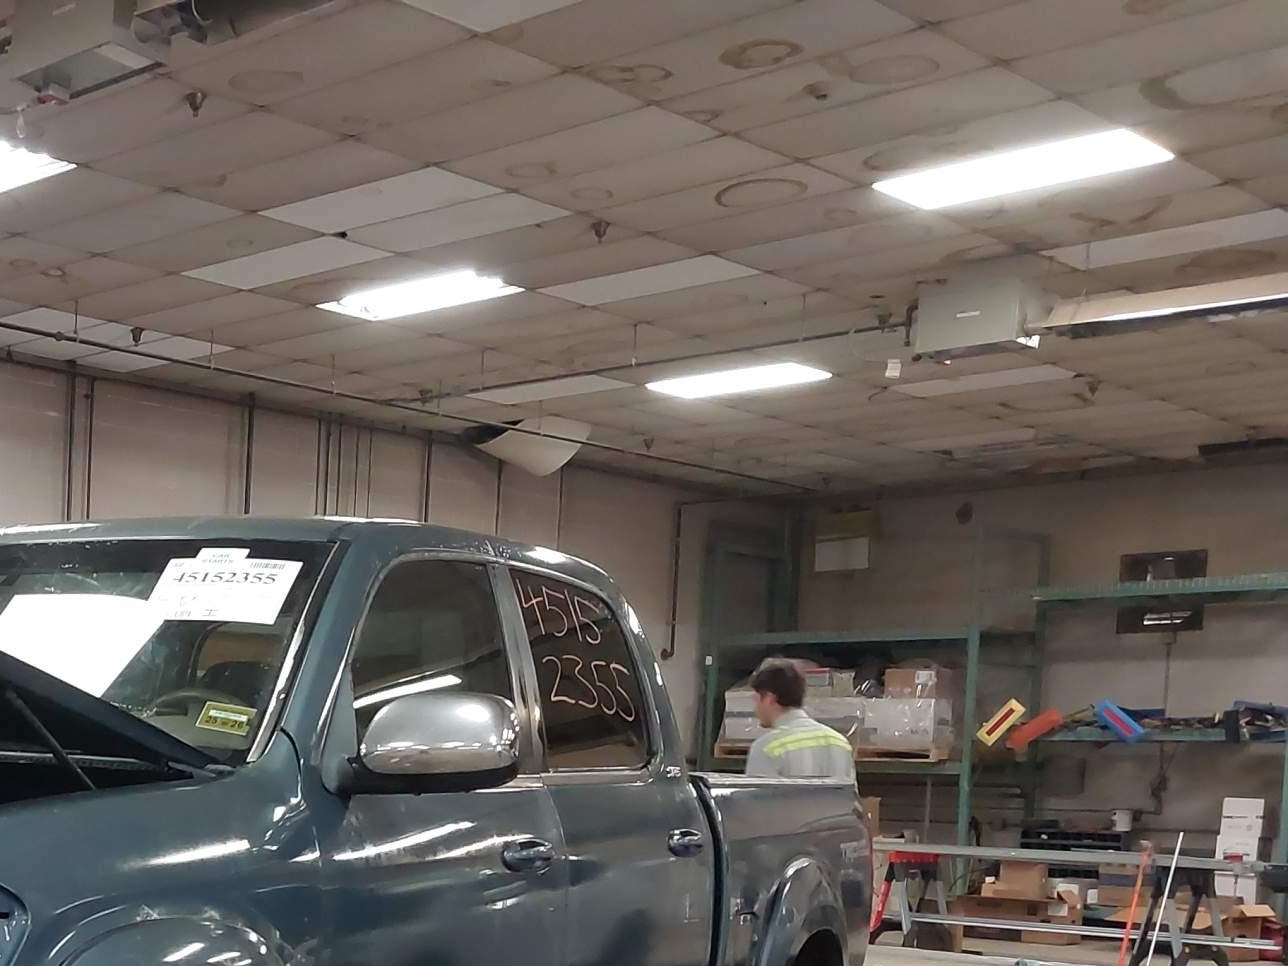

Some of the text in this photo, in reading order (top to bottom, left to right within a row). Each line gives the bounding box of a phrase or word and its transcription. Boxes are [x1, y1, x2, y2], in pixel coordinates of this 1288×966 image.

[172, 571, 279, 585] 45152355
[516, 578, 601, 644] 4515
[542, 654, 636, 722] 2355
